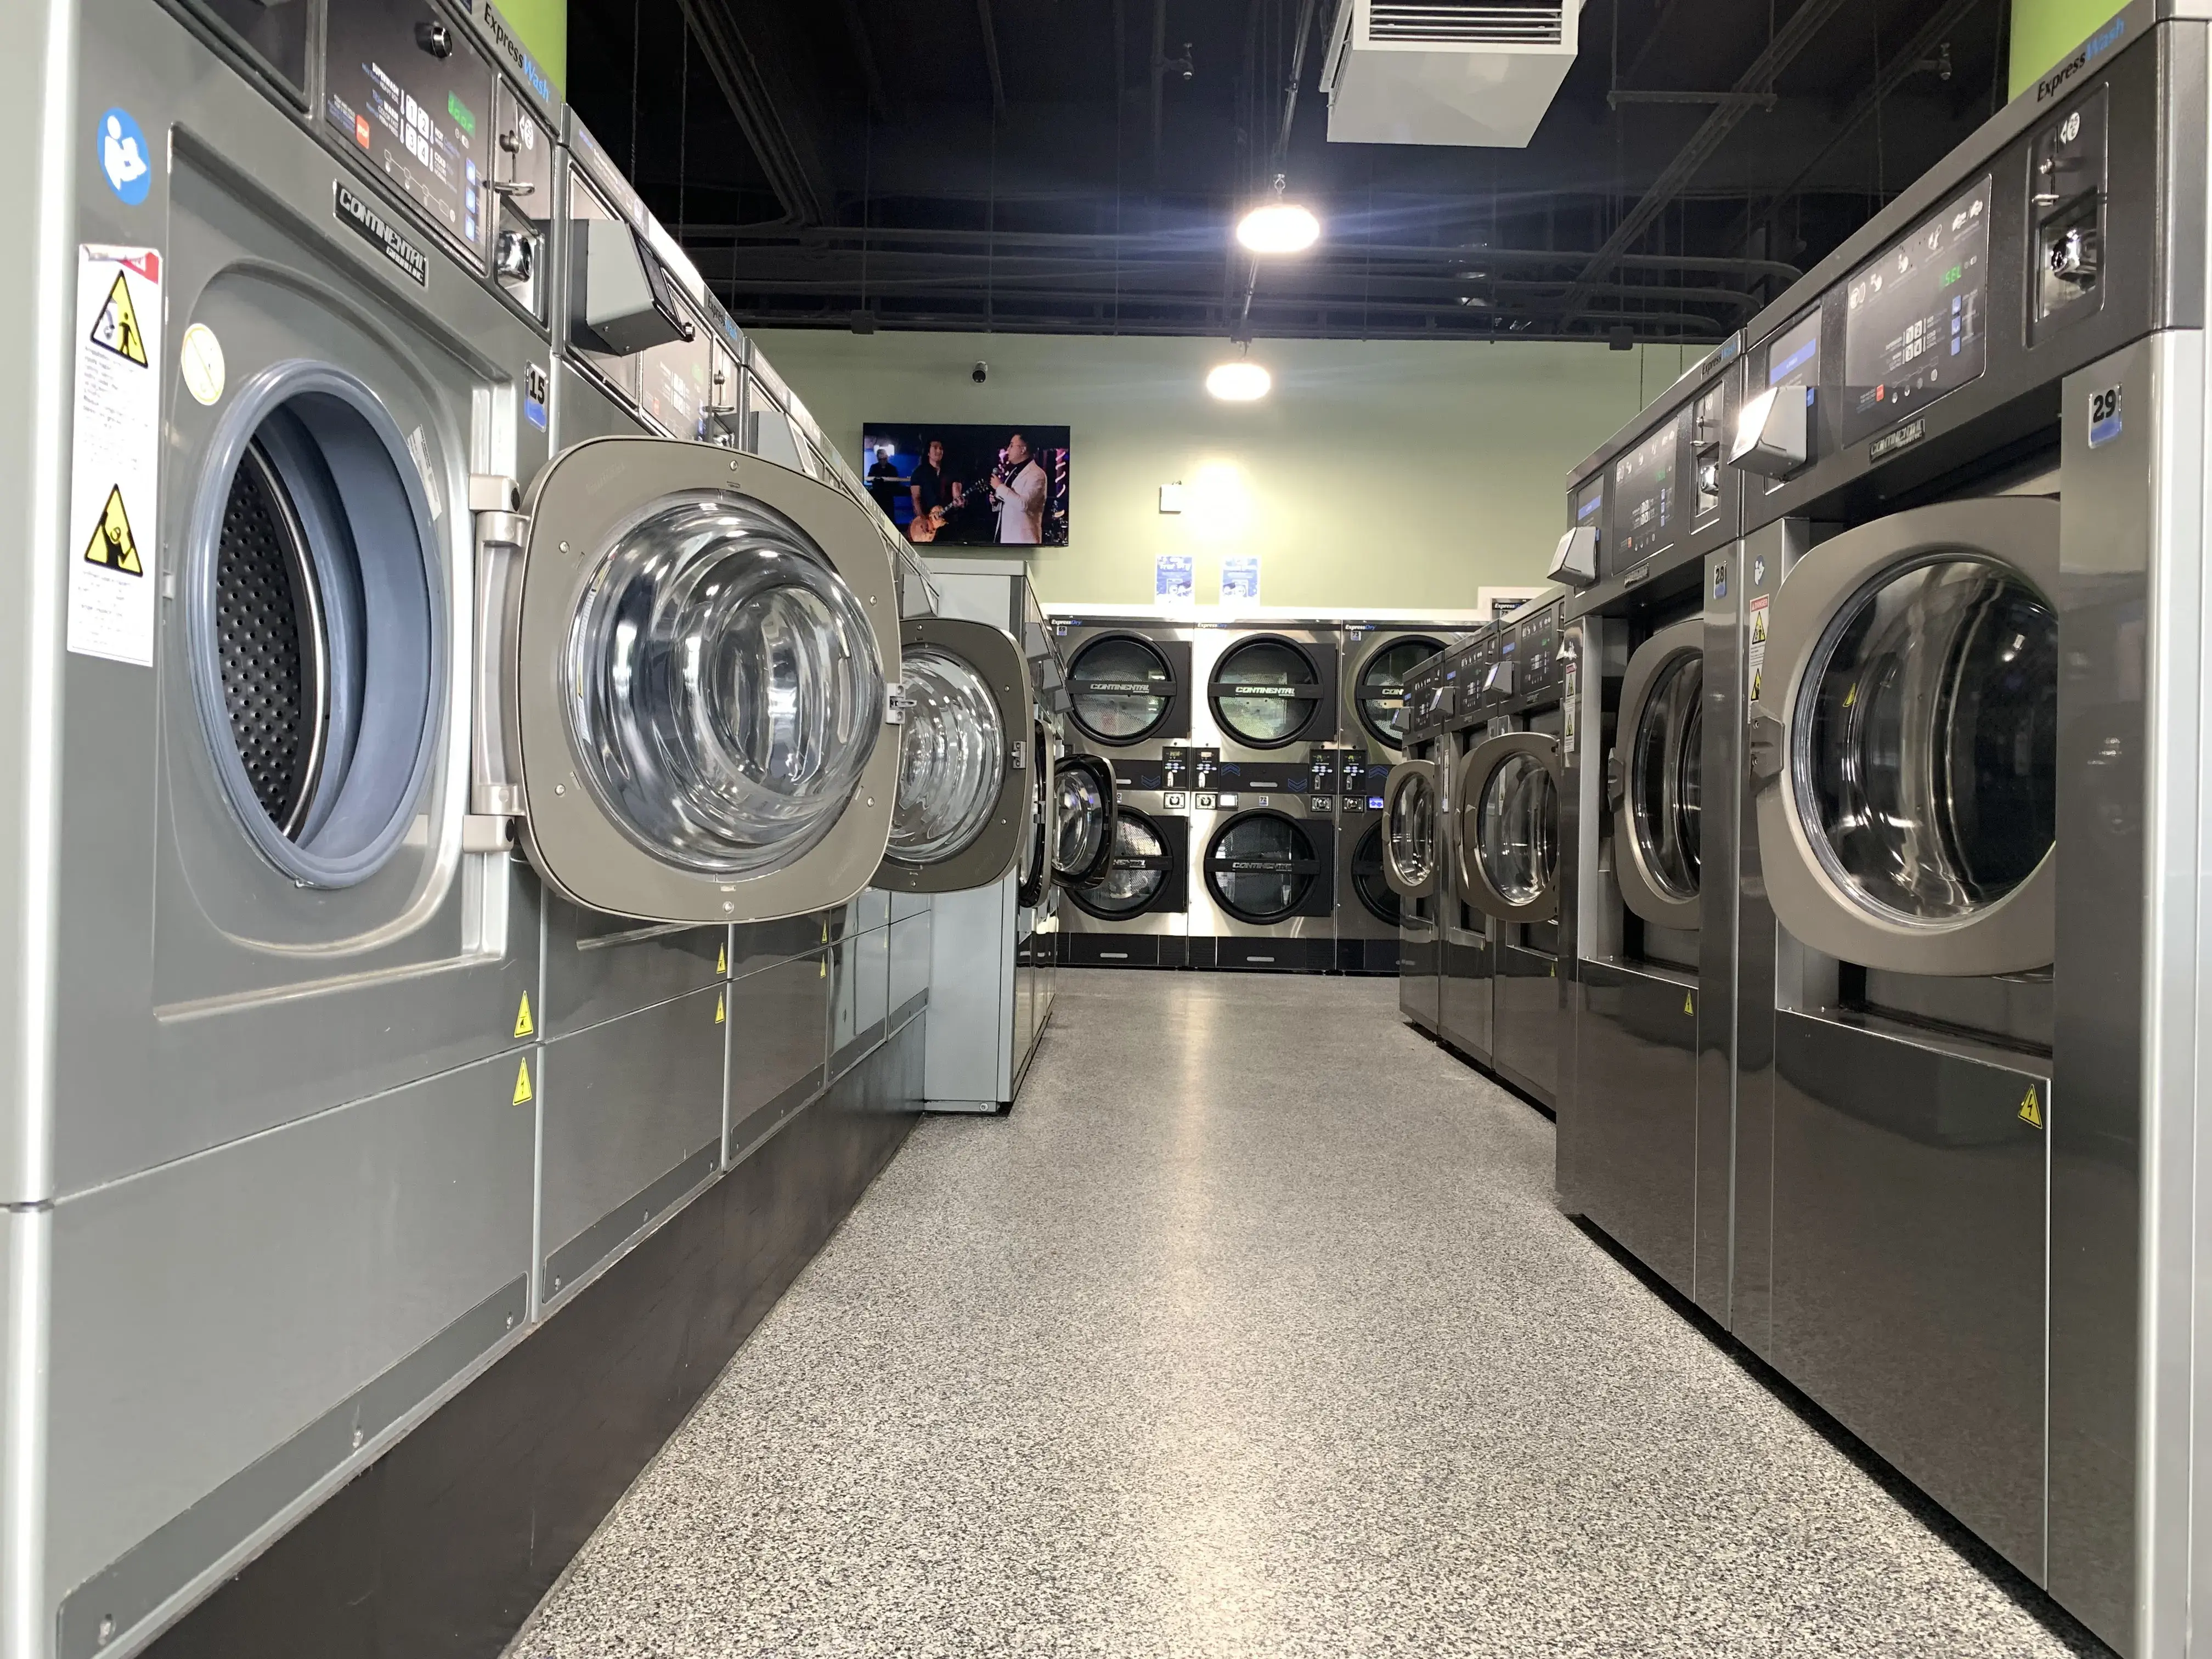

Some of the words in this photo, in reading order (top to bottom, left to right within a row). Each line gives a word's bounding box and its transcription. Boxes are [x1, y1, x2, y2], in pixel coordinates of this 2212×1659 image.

[339, 188, 424, 273] CONTINENTAL
[529, 370, 545, 404] 15
[2093, 389, 2117, 424] 29
[1715, 566, 1724, 585] 28
